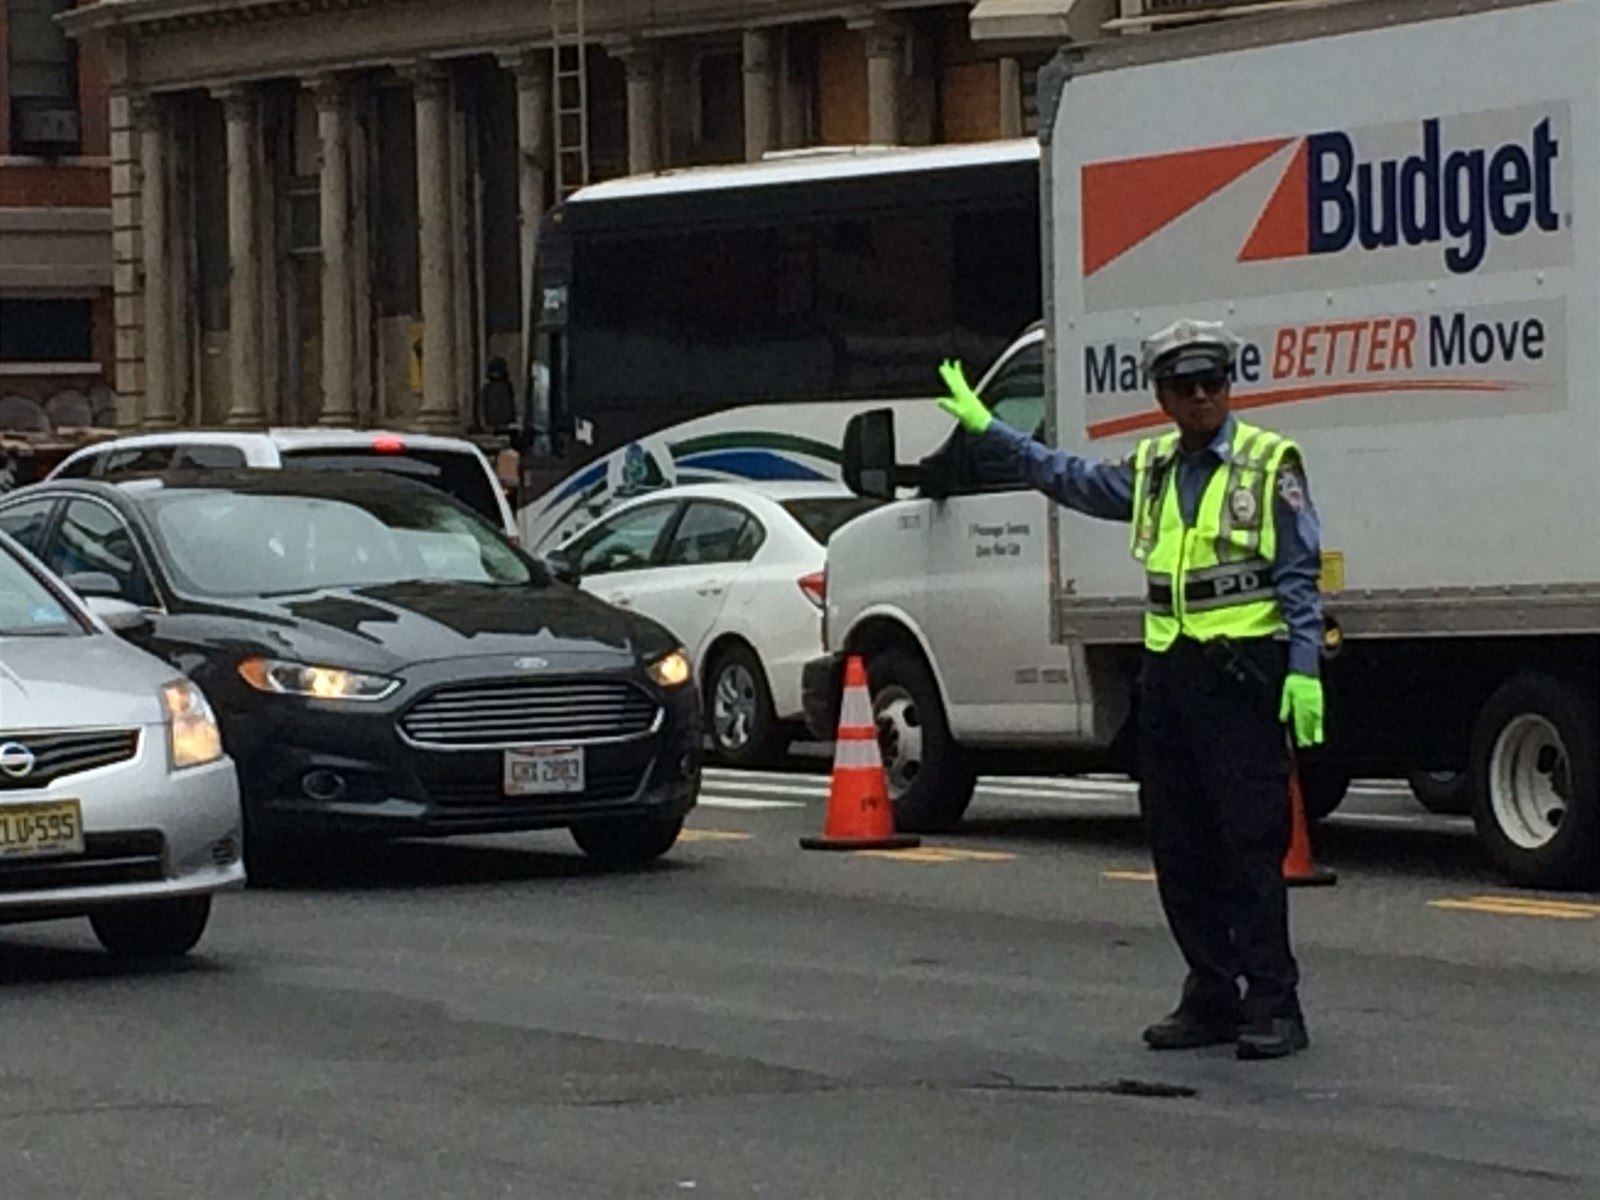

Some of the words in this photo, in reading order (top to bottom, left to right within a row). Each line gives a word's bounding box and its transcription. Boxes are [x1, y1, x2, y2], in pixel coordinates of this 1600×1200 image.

[1307, 117, 1558, 273] Budget
[1084, 340, 1149, 394] Ma
[1272, 317, 1417, 379] BETTER
[1429, 313, 1545, 368] Move
[1213, 572, 1259, 596] PD
